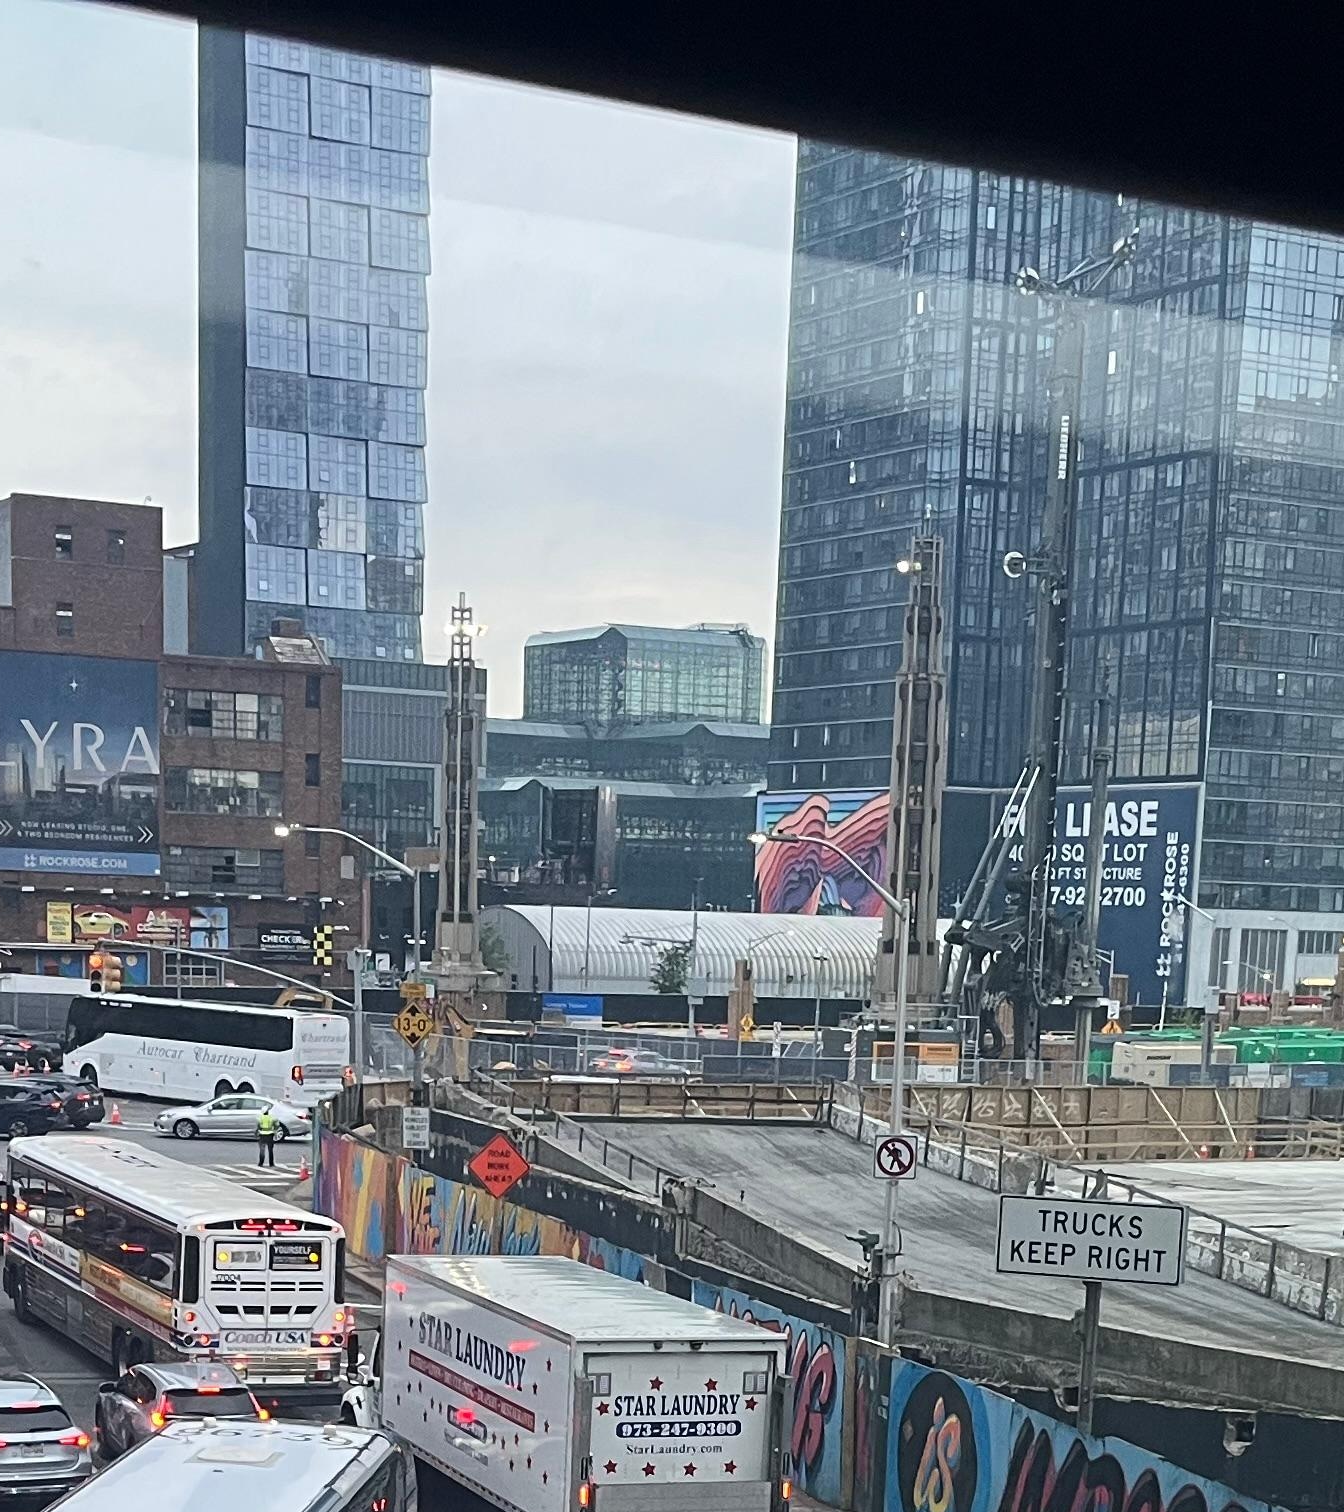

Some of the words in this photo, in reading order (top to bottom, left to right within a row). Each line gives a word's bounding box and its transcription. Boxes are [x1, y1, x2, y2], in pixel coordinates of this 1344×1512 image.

[39, 855, 128, 869] ROCKROSE.COM
[1061, 843, 1085, 862] SQ
[1113, 843, 1148, 862] LOT
[1159, 831, 1179, 947] ROCKROSE
[137, 1041, 184, 1060] Autocar
[193, 1046, 257, 1068] Chartrand
[1038, 1209, 1143, 1239] TRUCKS
[1010, 1240, 1076, 1266] KEEP
[1088, 1246, 1167, 1273] RIGHT
[225, 1331, 272, 1344] Coach
[275, 1331, 306, 1344] USA
[418, 1311, 453, 1358] STAR
[455, 1327, 526, 1392] LAUNDRY
[614, 1395, 656, 1417] STAR
[660, 1394, 741, 1416] LAUNDRY
[621, 1422, 737, 1437] 973-247-9300
[626, 1444, 723, 1456] StarLaundry.com
